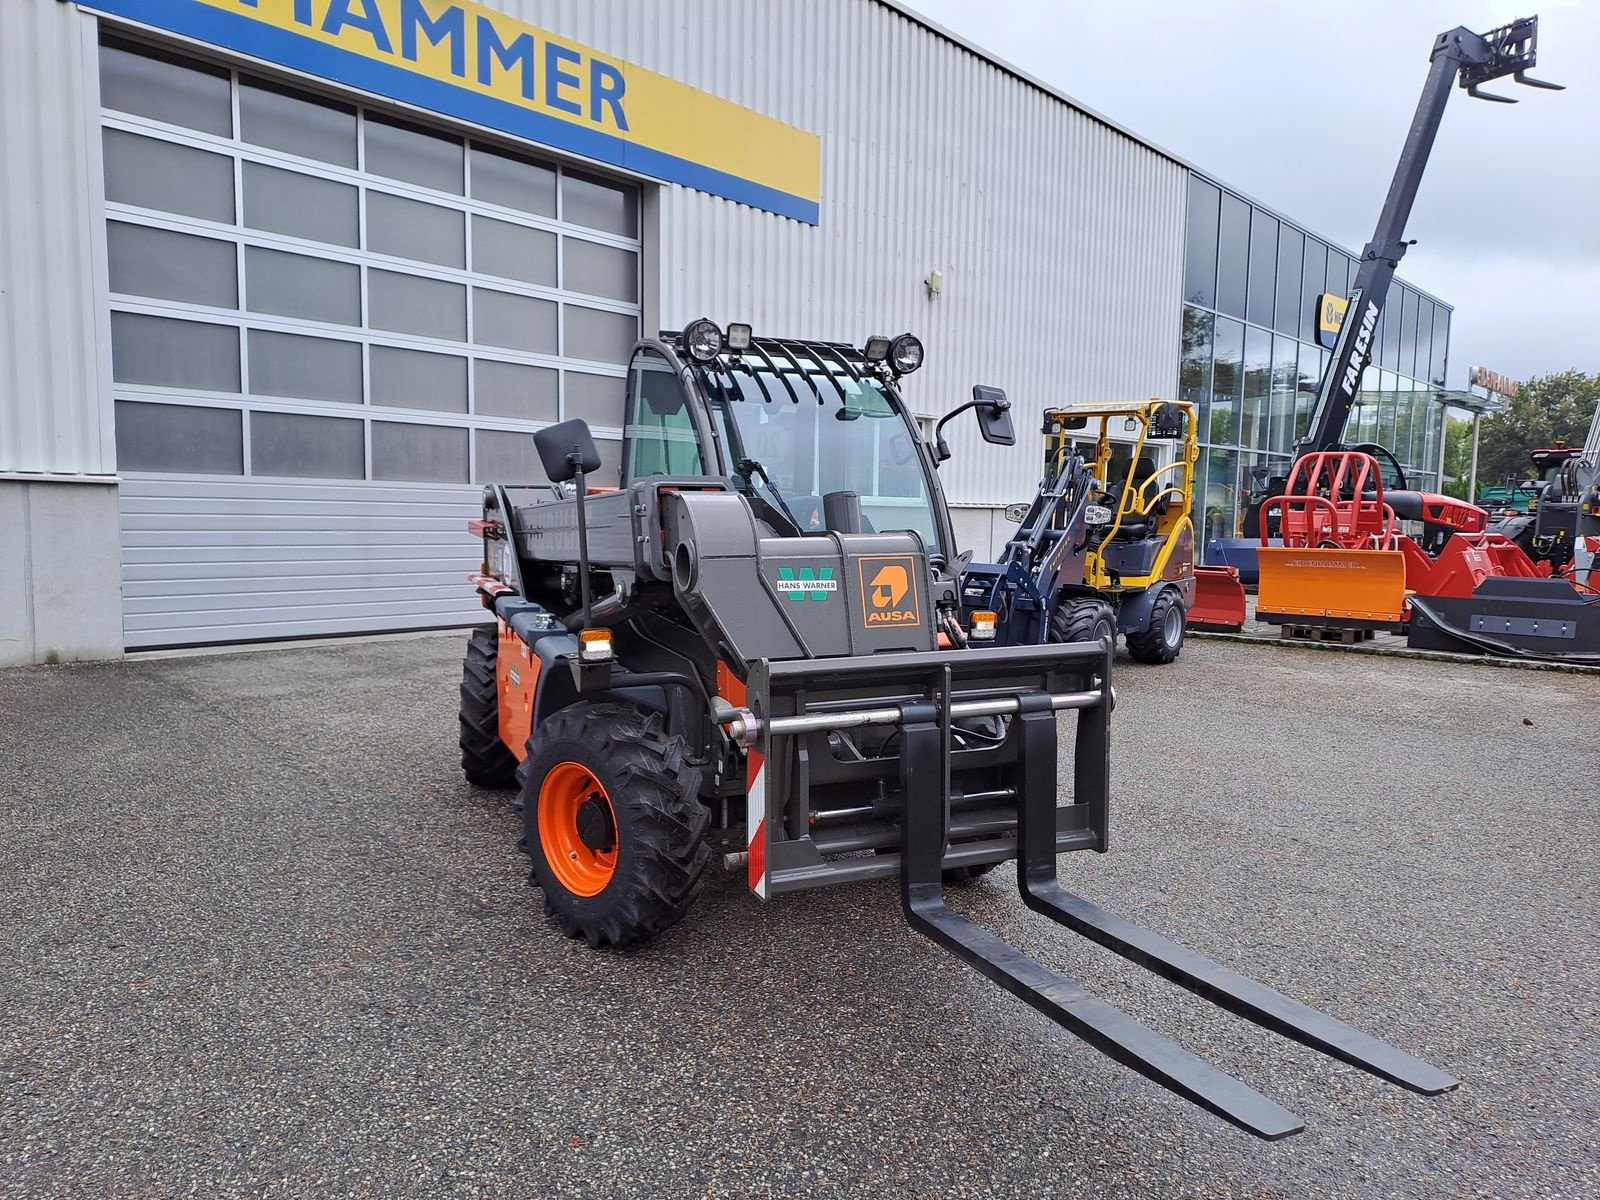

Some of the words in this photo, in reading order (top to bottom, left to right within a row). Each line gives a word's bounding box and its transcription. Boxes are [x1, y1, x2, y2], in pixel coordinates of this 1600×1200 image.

[239, 0, 629, 132] AMMER
[1341, 299, 1379, 397] FARESIN
[778, 582, 801, 590] HANS
[868, 611, 916, 621] AUSA
